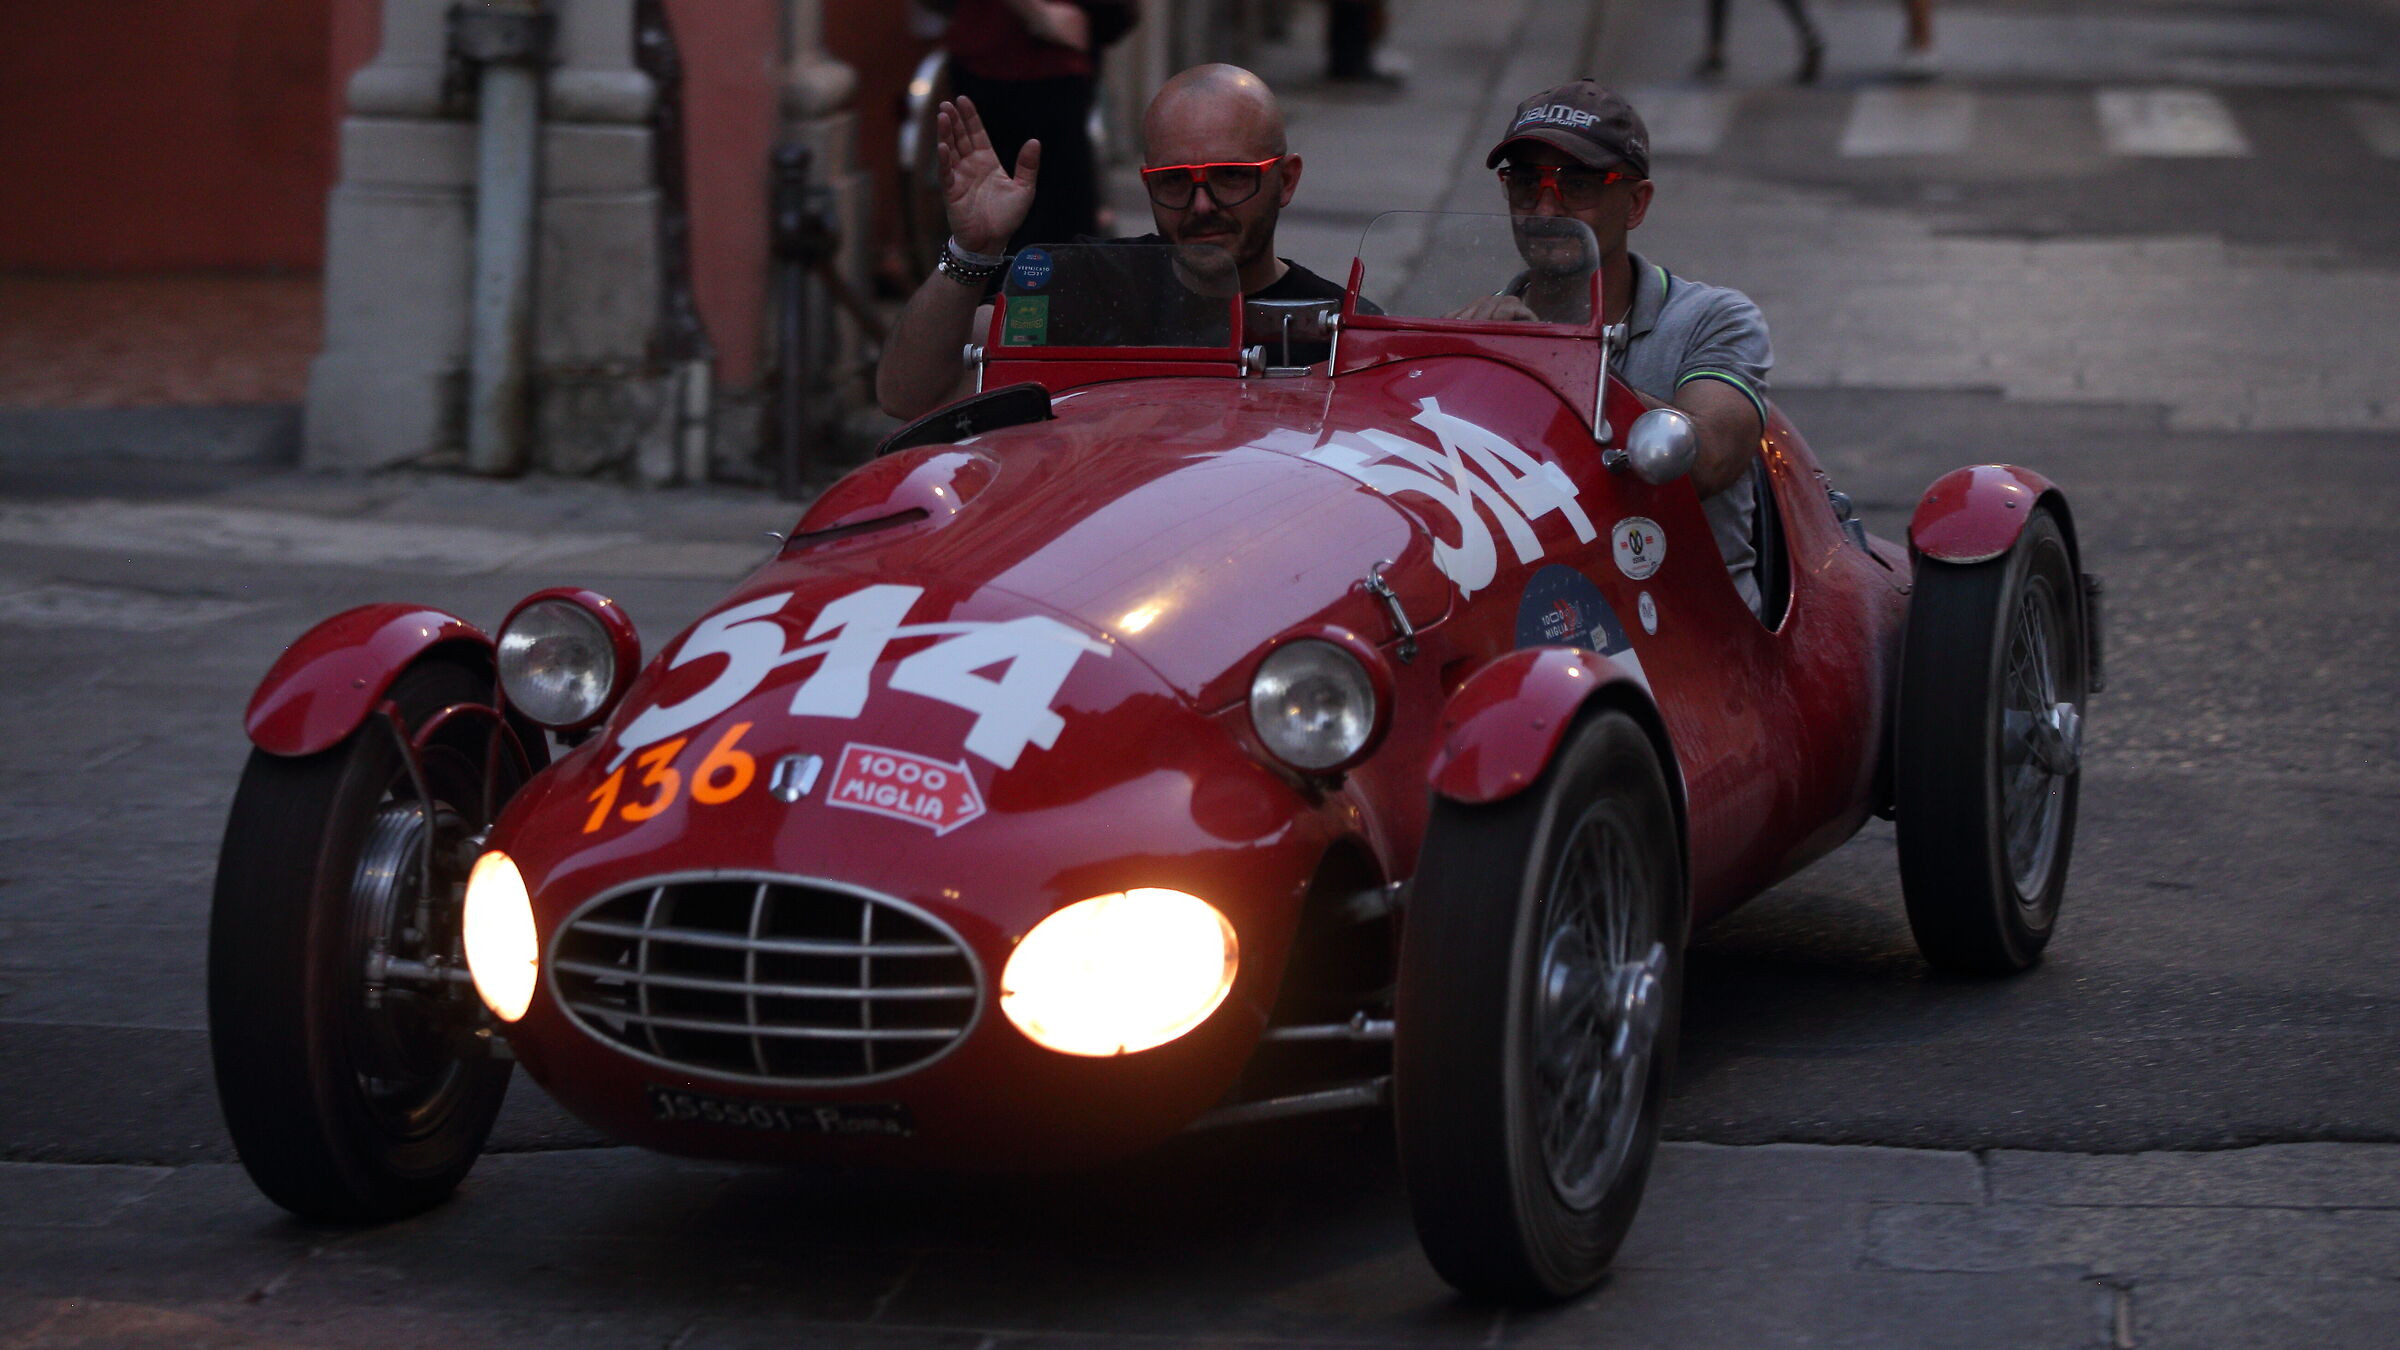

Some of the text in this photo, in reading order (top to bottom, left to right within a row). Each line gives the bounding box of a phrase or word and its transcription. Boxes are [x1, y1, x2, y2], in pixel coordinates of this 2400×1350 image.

[1301, 396, 1598, 602] 514
[1545, 623, 1569, 639] MIGLIA
[606, 584, 1112, 770] 514
[582, 722, 756, 834] 136
[841, 779, 944, 821] MIGLIA
[858, 753, 948, 789] 1000
